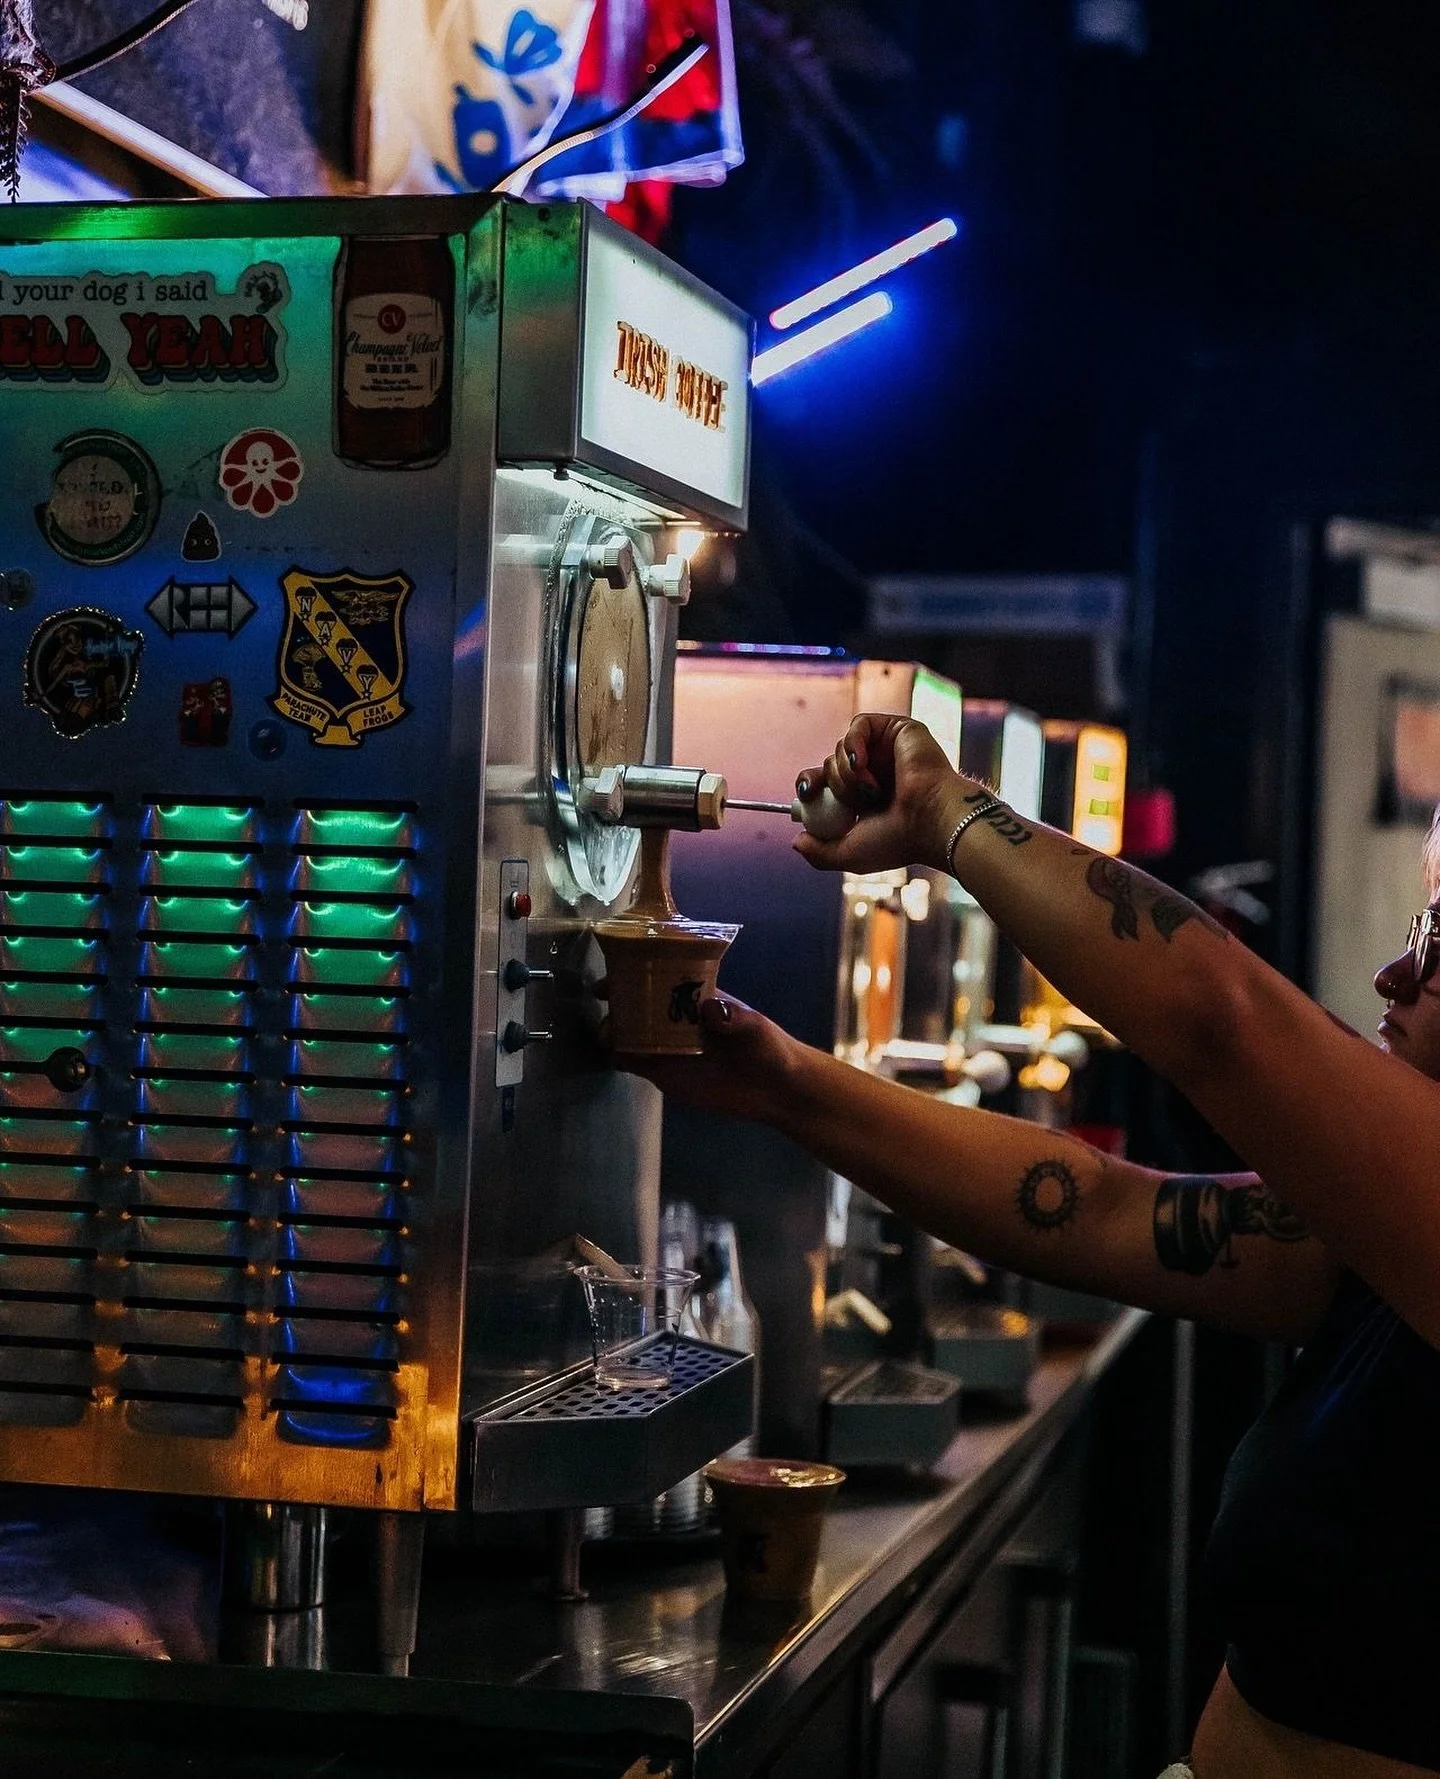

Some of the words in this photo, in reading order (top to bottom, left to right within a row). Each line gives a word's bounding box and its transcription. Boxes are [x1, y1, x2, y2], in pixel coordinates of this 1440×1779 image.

[13, 284, 73, 305] your
[83, 281, 128, 305] dog
[136, 281, 145, 301] i
[156, 281, 208, 301] said
[120, 313, 278, 385] YEAH
[346, 331, 407, 360] Champagne
[282, 692, 327, 721] PARACHUTE
[363, 705, 387, 718] LEAP
